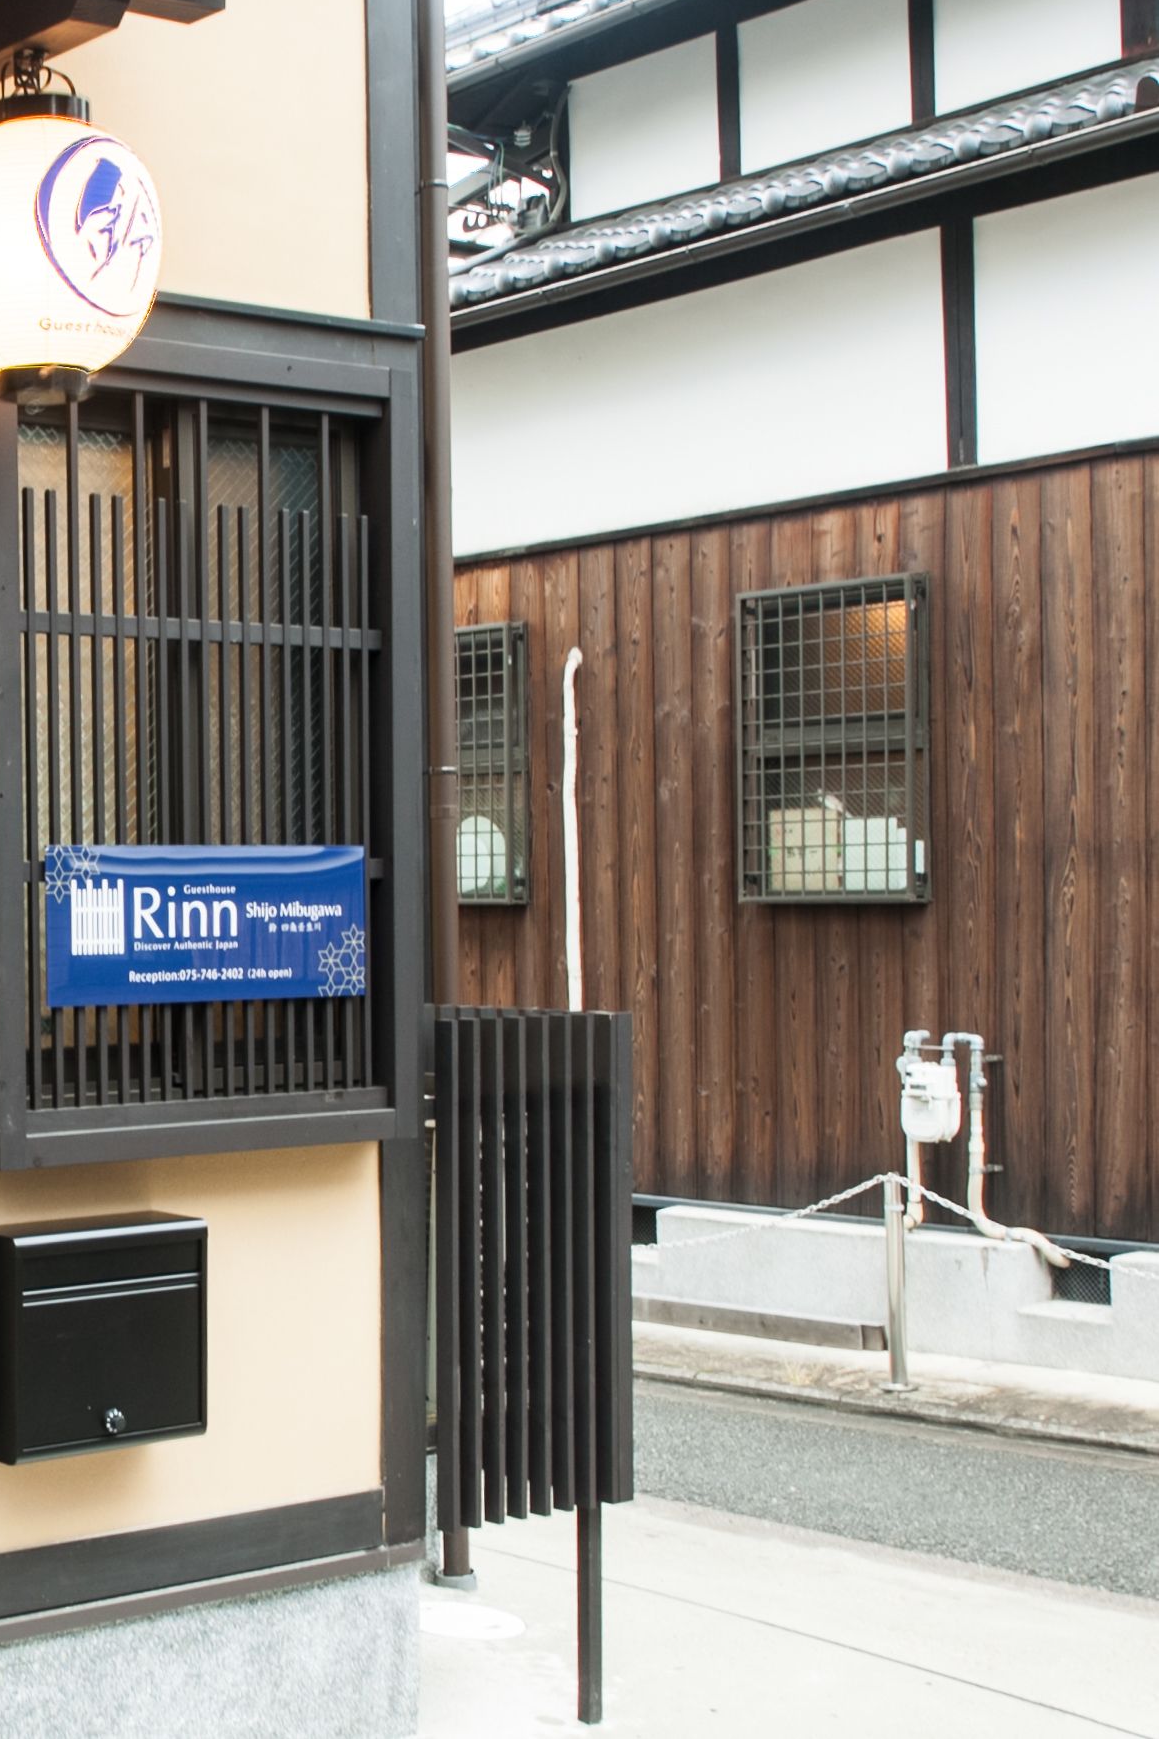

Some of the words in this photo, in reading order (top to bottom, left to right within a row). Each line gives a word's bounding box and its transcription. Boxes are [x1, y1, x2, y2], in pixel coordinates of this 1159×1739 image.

[183, 883, 236, 895] Guesthouse
[133, 885, 238, 939] Rinn
[245, 901, 278, 922] Shijo
[279, 900, 343, 921] Mibugawa
[133, 941, 171, 952] Discover
[173, 940, 213, 951] Authentic
[215, 940, 239, 952] Japan
[247, 966, 267, 980] (24h
[268, 966, 293, 980] open)
